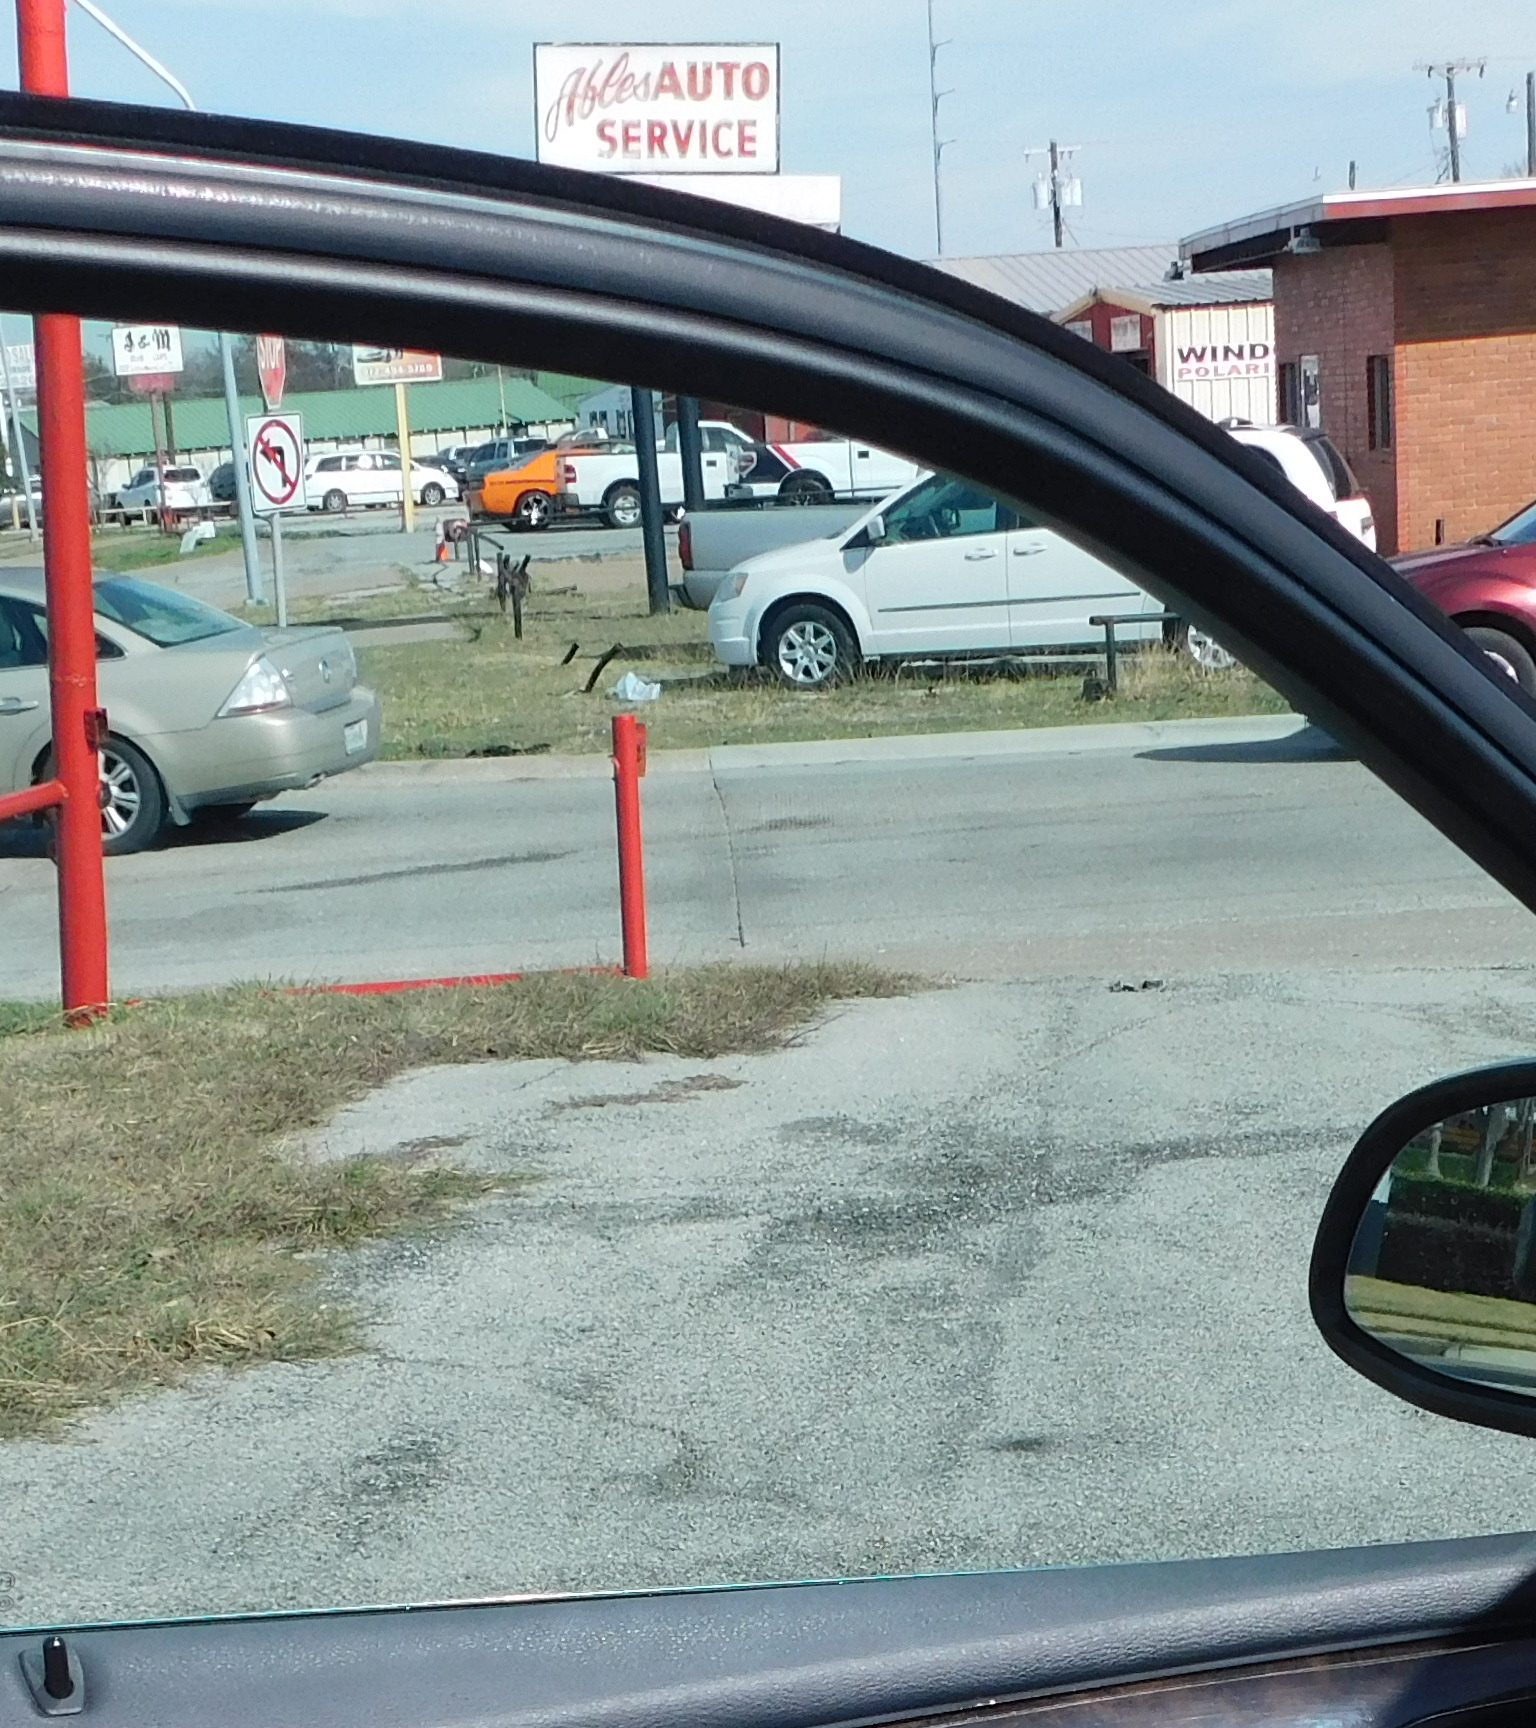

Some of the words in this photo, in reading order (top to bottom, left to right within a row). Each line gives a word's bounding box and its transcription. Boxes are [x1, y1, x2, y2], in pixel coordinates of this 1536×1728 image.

[651, 60, 770, 101] AUTO
[595, 118, 758, 159] SERVICE
[257, 336, 284, 369] STOP
[1177, 343, 1270, 364] WIND
[1178, 363, 1270, 379] POLARI
